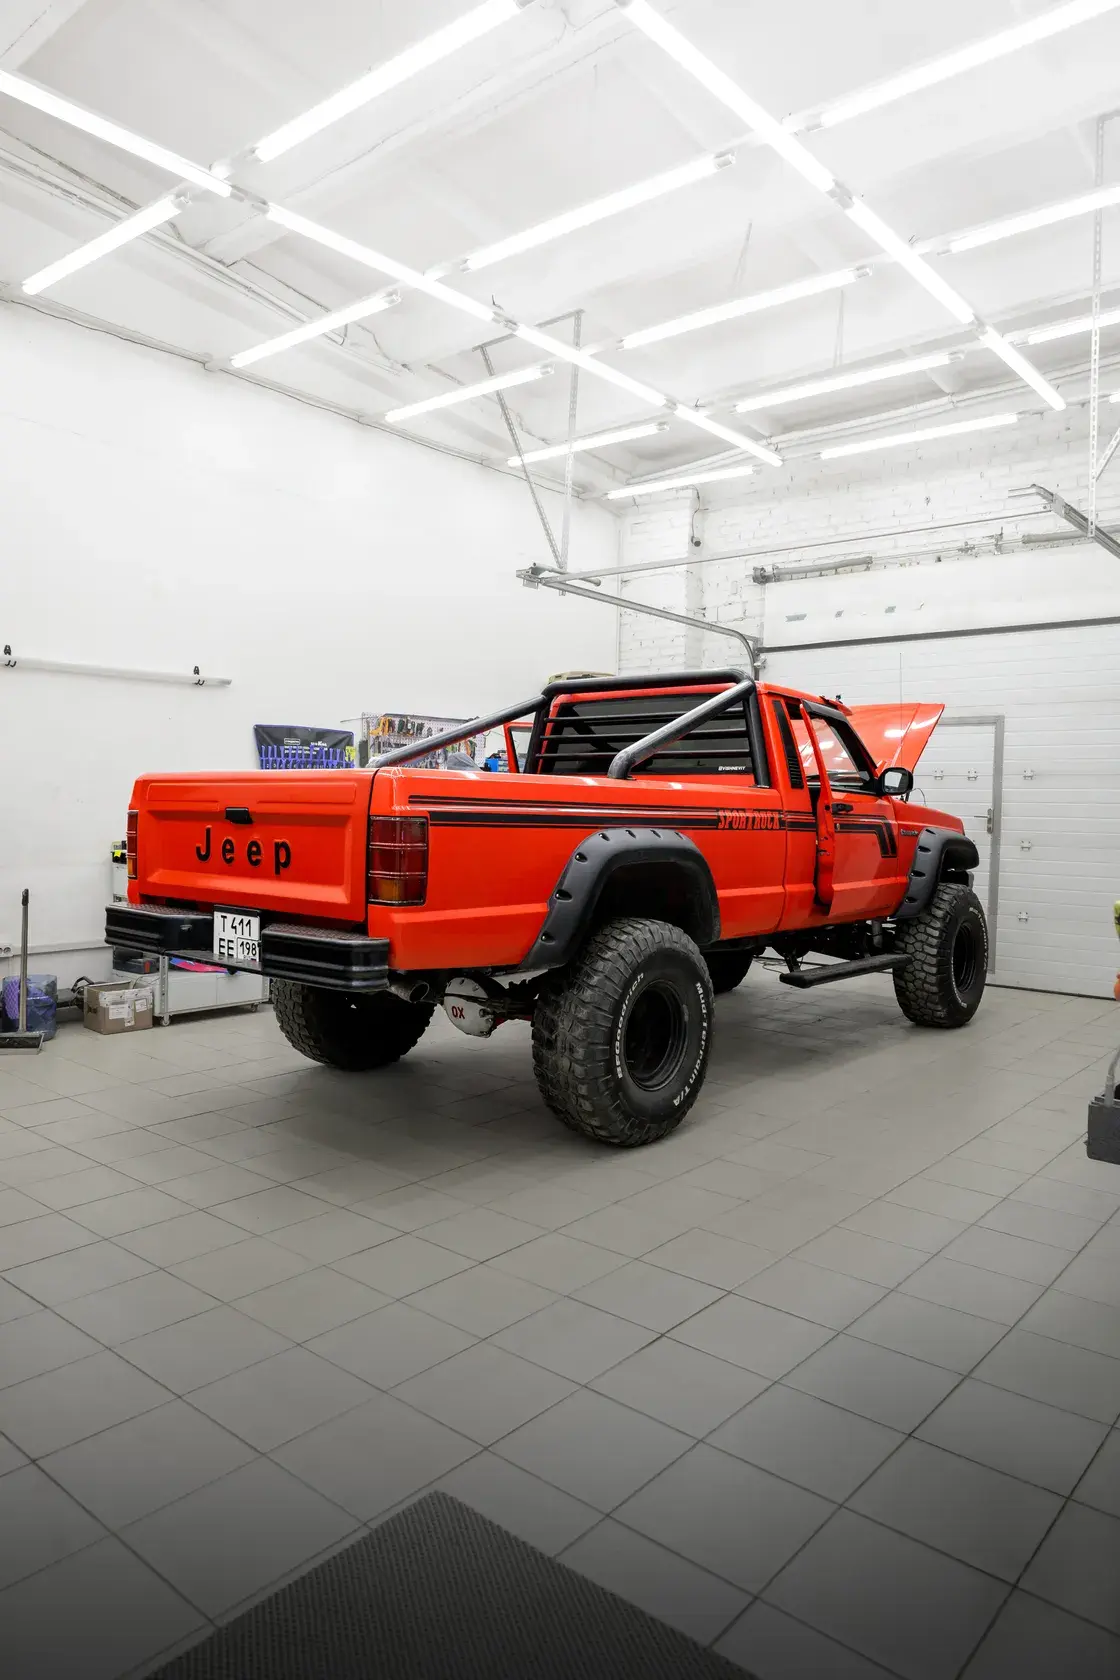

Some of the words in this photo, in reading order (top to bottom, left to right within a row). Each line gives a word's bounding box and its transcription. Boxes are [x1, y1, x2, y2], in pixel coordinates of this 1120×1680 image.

[195, 826, 291, 875] Jeep
[220, 914, 228, 933] T
[231, 916, 252, 937] 411
[218, 937, 235, 957] EE
[239, 940, 257, 957] 198
